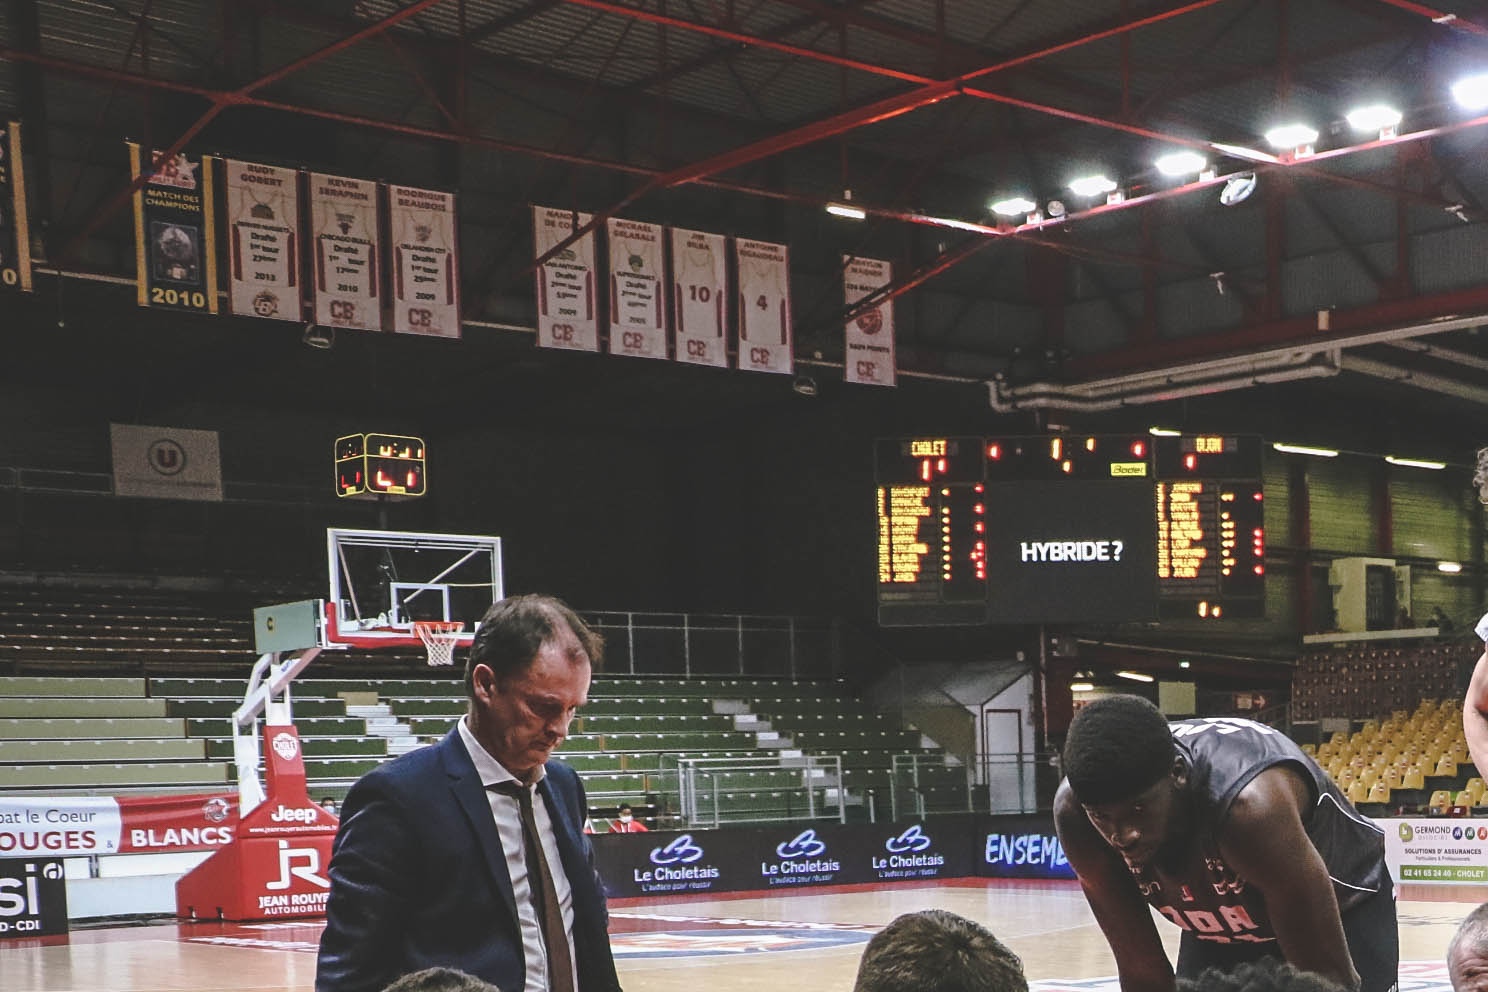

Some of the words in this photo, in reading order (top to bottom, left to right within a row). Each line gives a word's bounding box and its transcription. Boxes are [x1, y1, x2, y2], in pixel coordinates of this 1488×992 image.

[240, 174, 284, 187] GOBERT
[327, 177, 360, 190] KEVIN
[148, 189, 181, 201] MATCH
[145, 198, 201, 212] CHAMPIONS
[545, 210, 579, 221] NAND
[152, 287, 205, 308] 2010
[688, 284, 711, 304] 10
[755, 294, 769, 311] 4
[26, 808, 40, 824] le
[45, 808, 97, 823] Coeur
[271, 804, 317, 824] Jeep
[131, 826, 233, 848] BLANCS
[1414, 825, 1451, 834] GERMOND
[761, 861, 778, 876] Le
[780, 859, 840, 874] Choletais
[872, 855, 887, 869] Le
[889, 852, 945, 868] Choletais
[634, 867, 652, 882] Le
[653, 864, 720, 881] Choletais
[1456, 869, 1485, 878] CHOLET
[259, 895, 288, 909] JEAN
